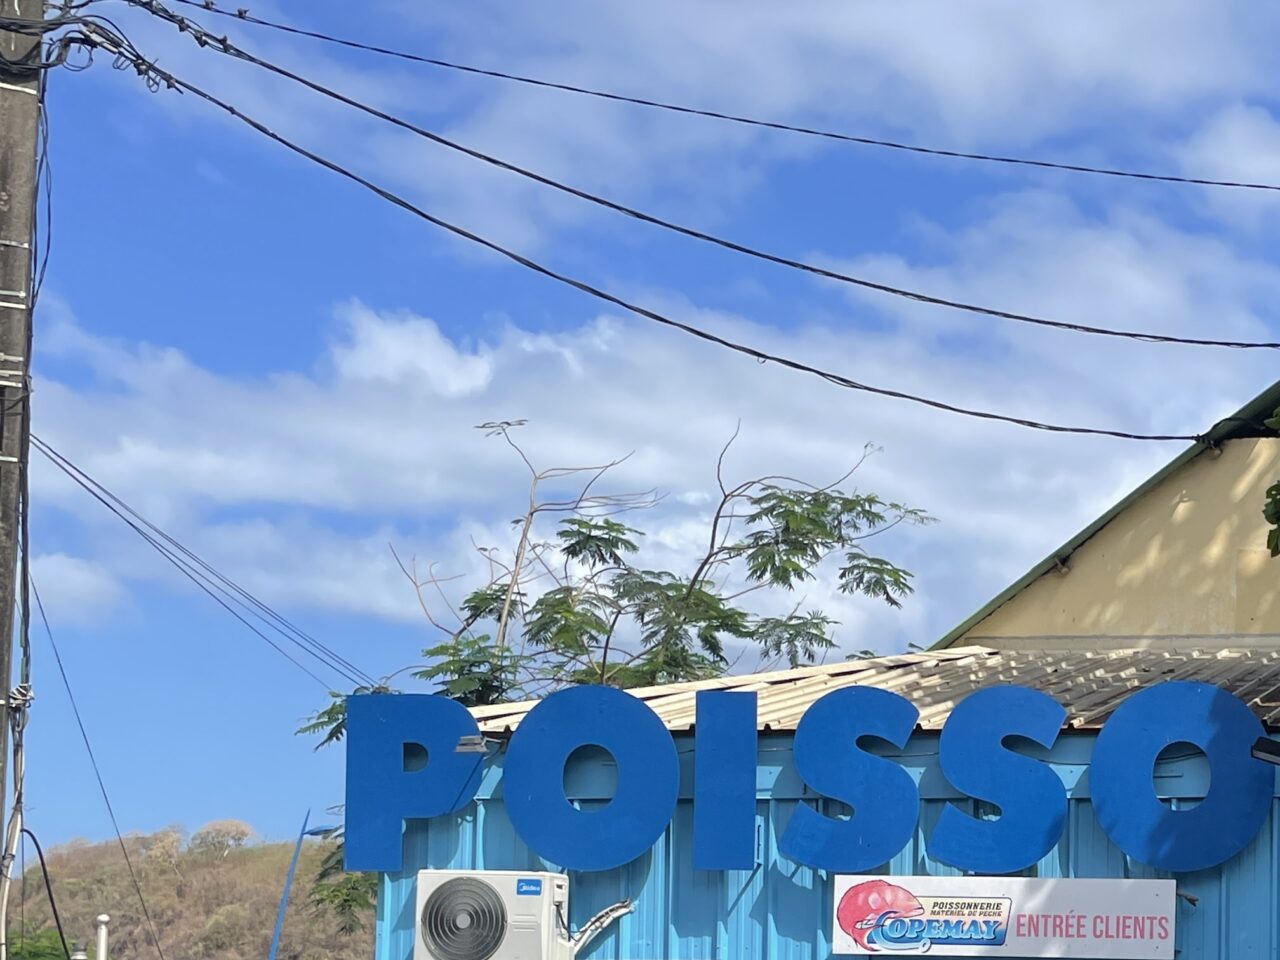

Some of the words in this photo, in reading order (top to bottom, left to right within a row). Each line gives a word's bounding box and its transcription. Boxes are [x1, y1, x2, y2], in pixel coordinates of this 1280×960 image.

[932, 901, 1003, 911] POISSONNERIE
[1015, 909, 1087, 939] ENTRÉE
[1092, 914, 1169, 941] CLIENTS
